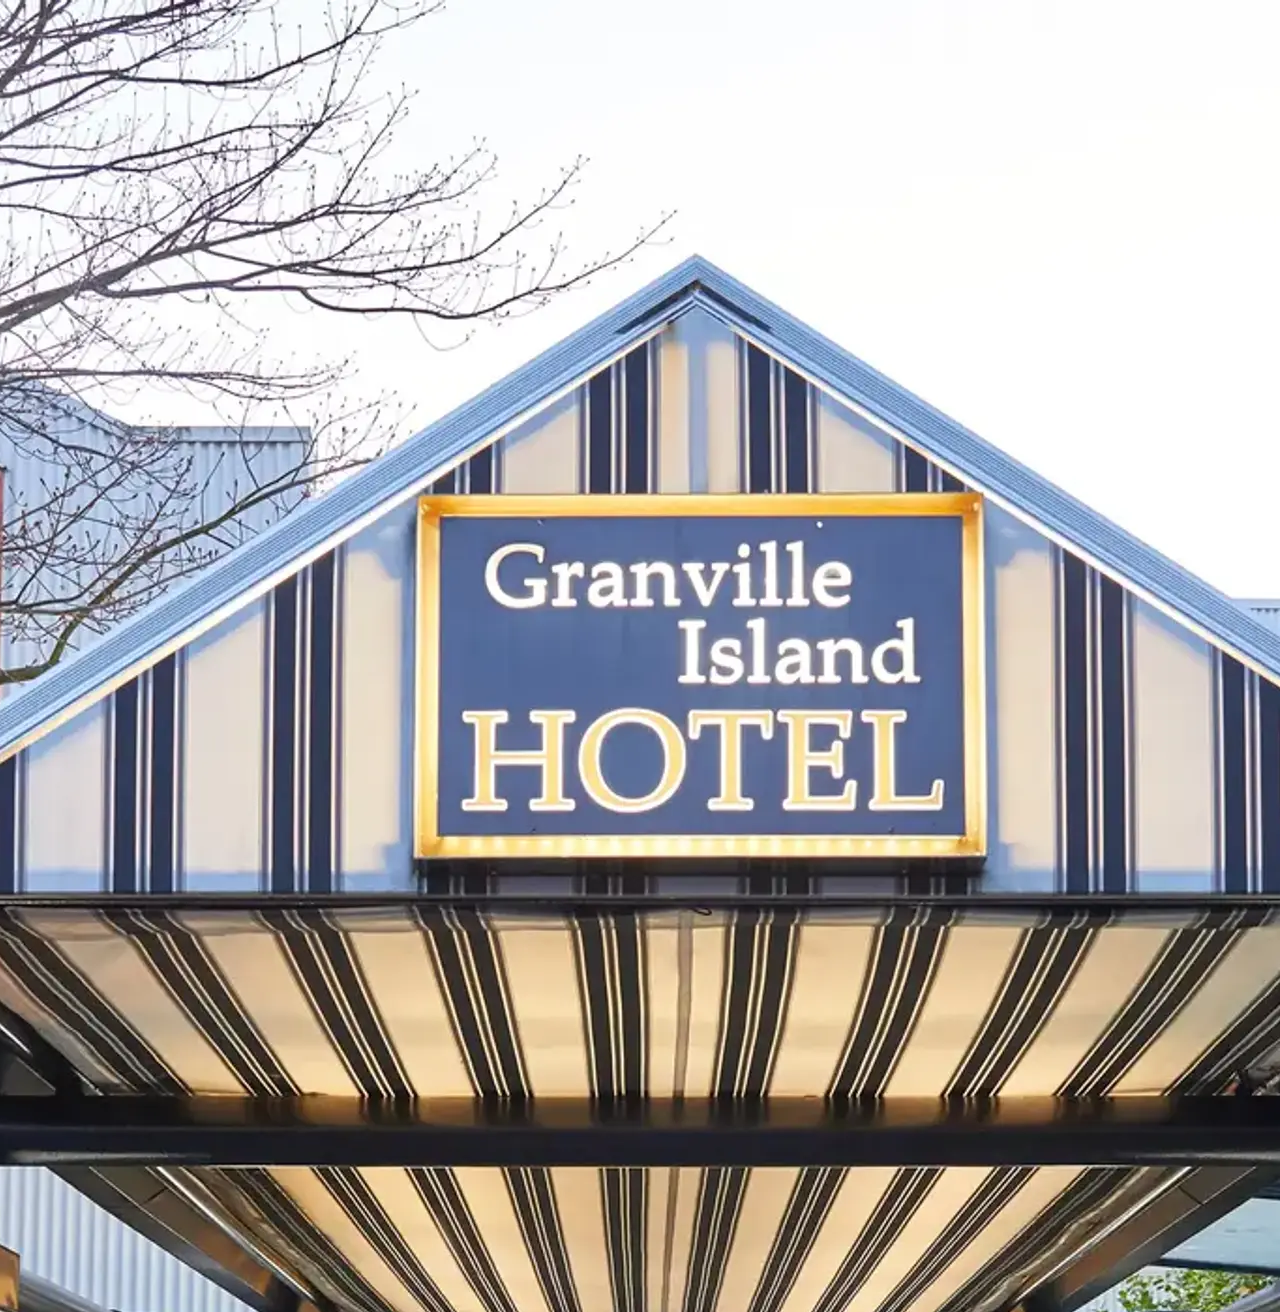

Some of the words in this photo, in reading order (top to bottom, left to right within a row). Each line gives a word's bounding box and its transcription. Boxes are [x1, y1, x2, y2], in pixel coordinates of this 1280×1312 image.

[484, 539, 853, 610] Granville
[677, 616, 922, 687] Island
[460, 706, 946, 814] HOTEL
